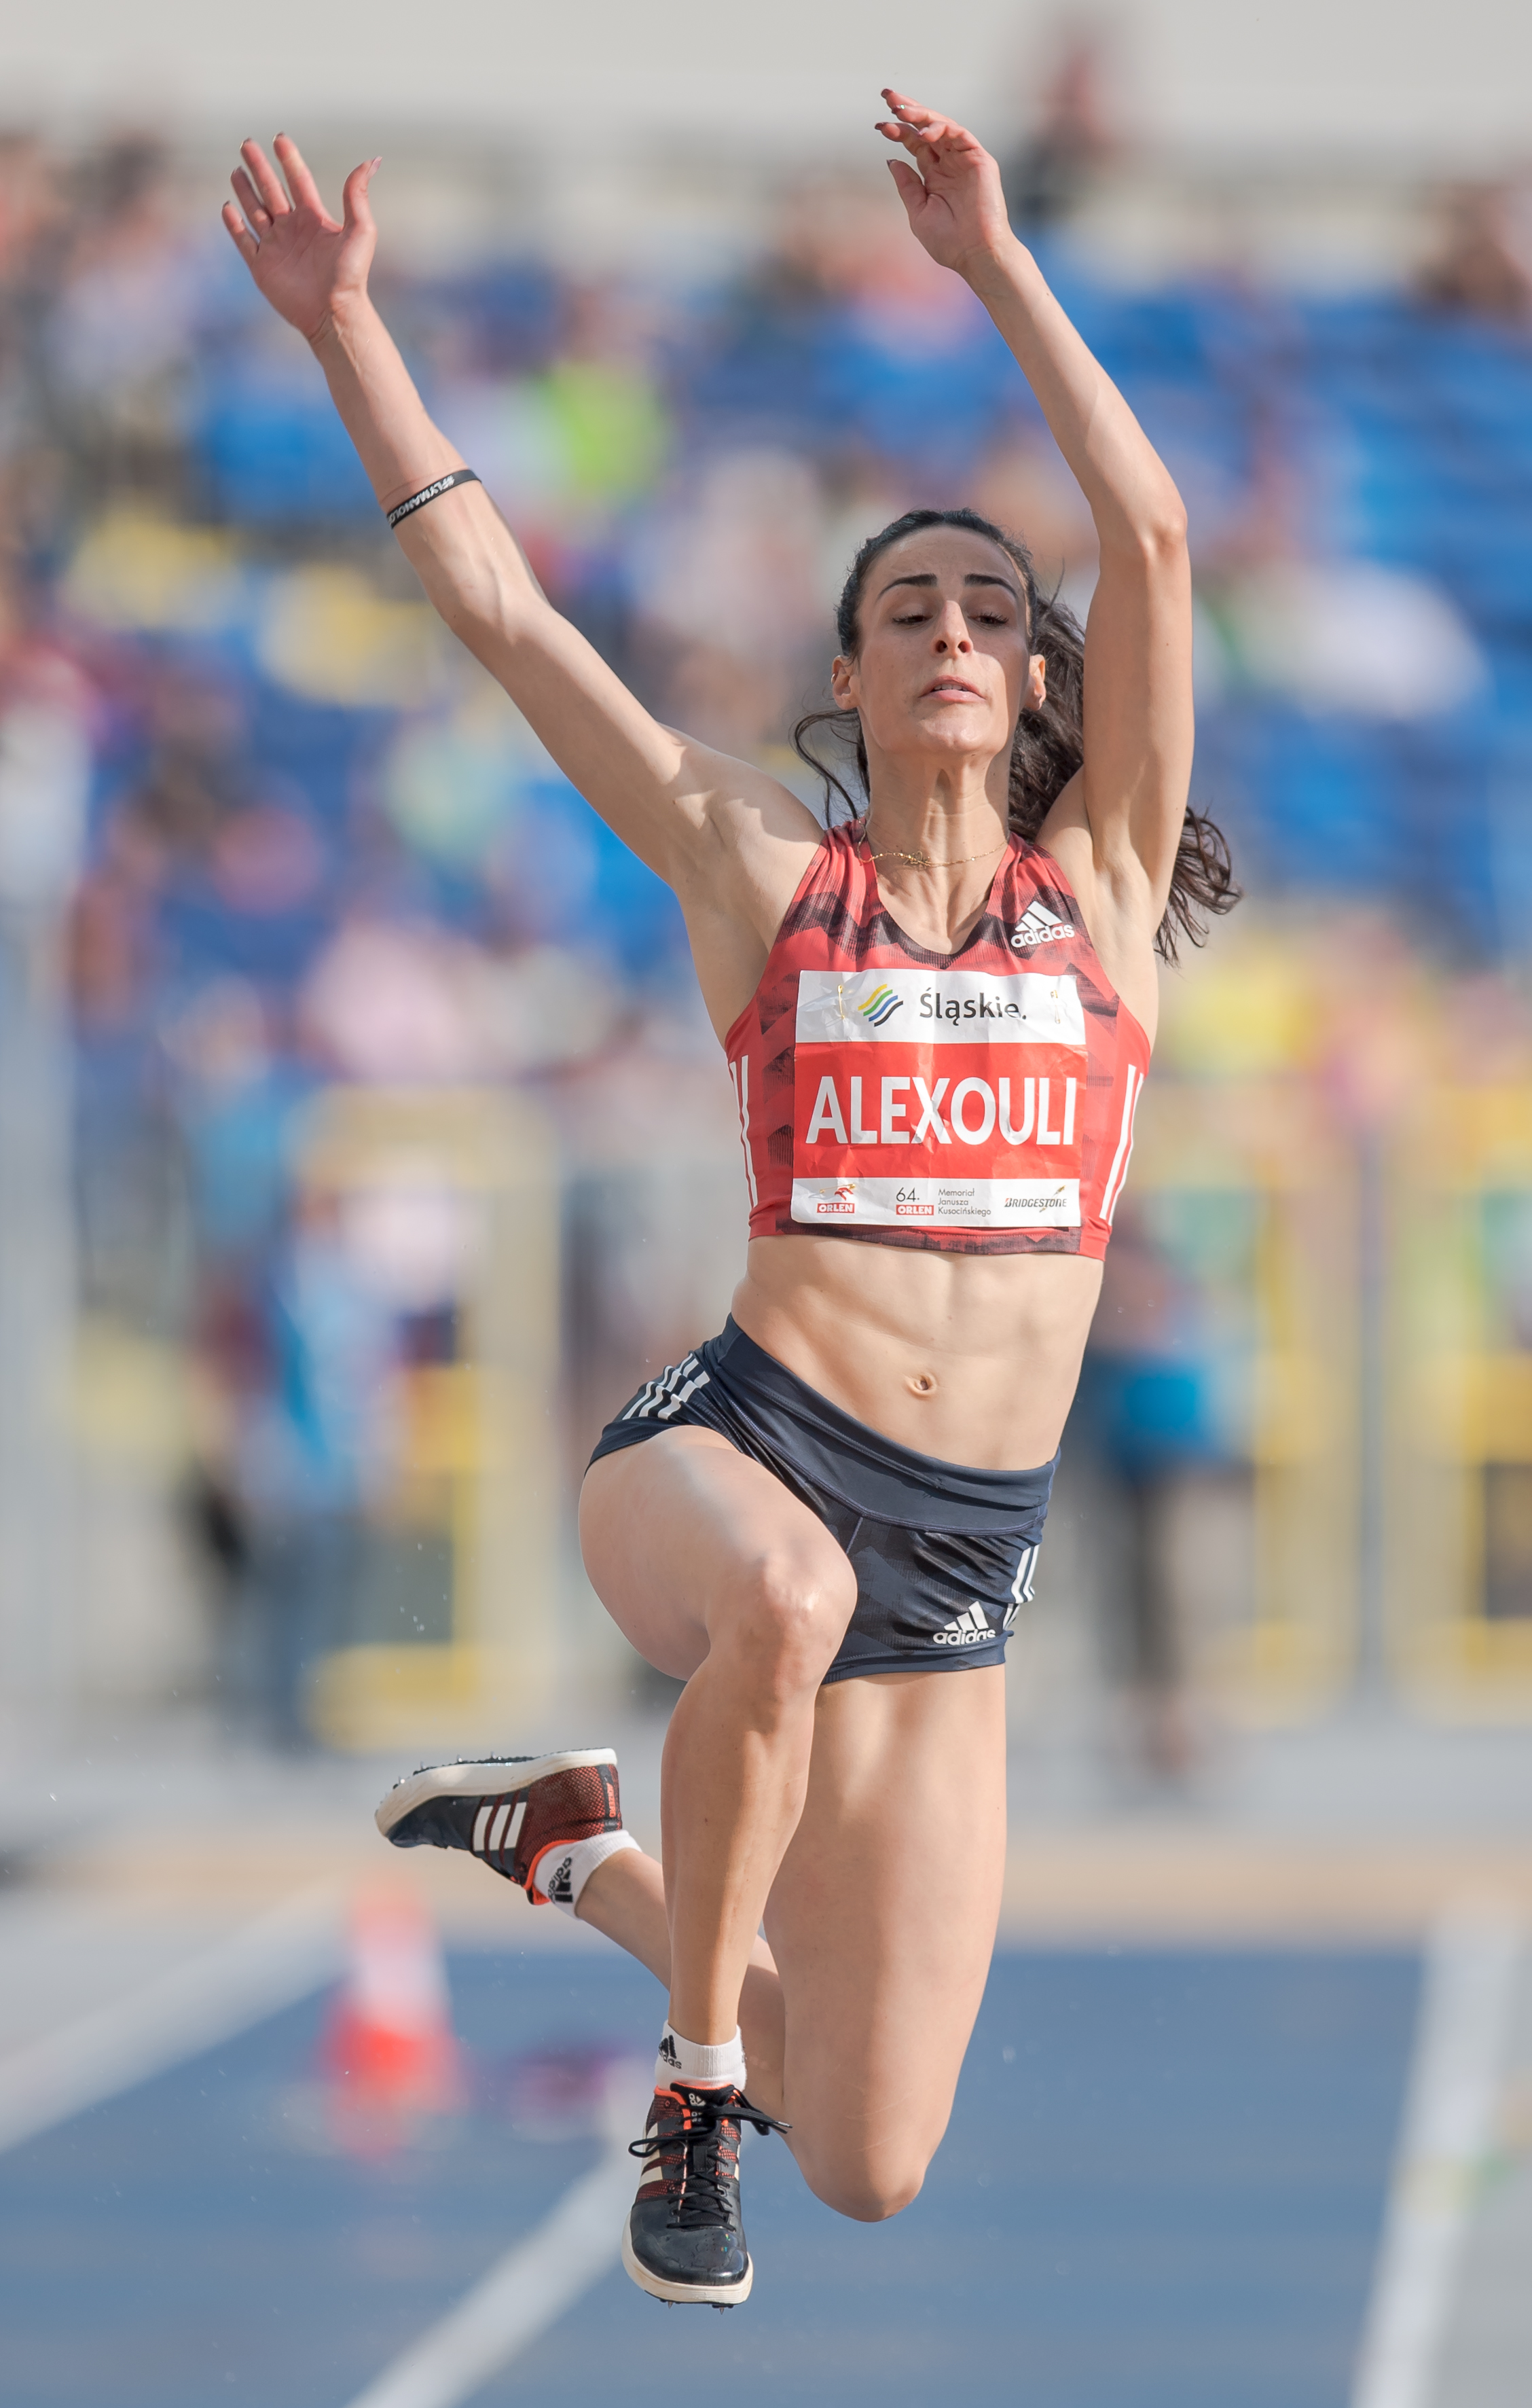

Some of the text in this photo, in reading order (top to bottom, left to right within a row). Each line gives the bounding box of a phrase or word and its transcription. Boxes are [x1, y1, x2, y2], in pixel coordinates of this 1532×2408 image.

[388, 475, 455, 526] #FLYMANOLO
[1010, 924, 1075, 948] adidas
[919, 987, 1027, 1026] Śląskie.
[805, 1076, 1077, 1145] ALEXOULI
[896, 1187, 919, 1202] 64.
[938, 1188, 975, 1197] Memoriał
[818, 1204, 854, 1212] ORLEN
[938, 1198, 969, 1206] Janusza
[1004, 1198, 1067, 1208] BRIDGESTONE
[897, 1206, 933, 1215] ORLEN
[938, 1206, 991, 1217] Kusocińskiego
[932, 1628, 996, 1646] adidas
